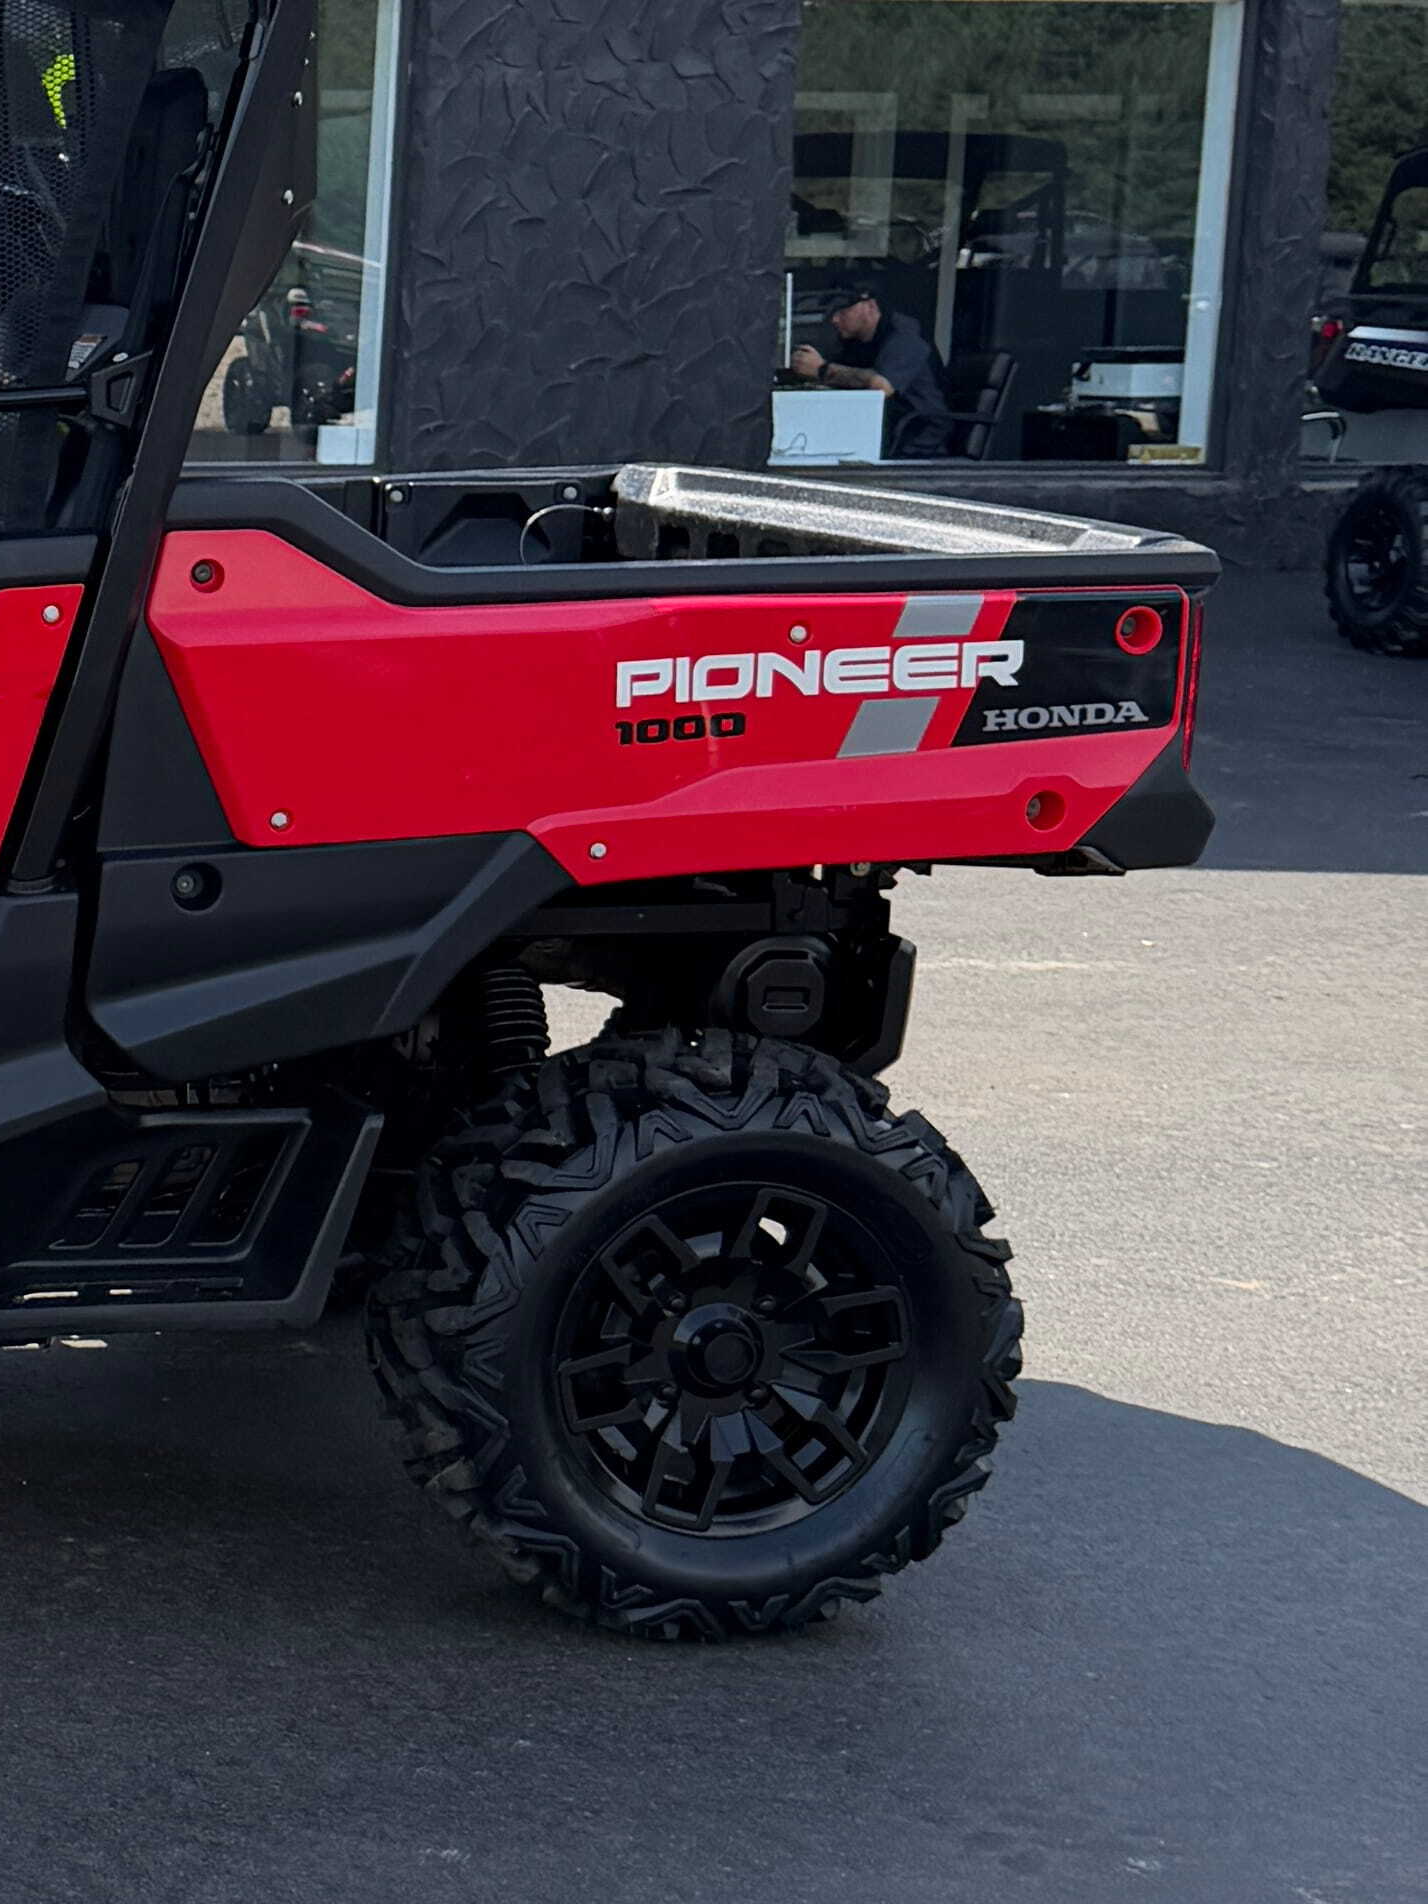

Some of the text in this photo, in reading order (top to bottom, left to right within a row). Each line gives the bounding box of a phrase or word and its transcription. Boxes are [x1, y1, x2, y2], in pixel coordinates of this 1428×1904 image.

[616, 640, 1024, 708] PIONEER
[615, 712, 746, 745] 1000
[982, 701, 1149, 732] HONDA
